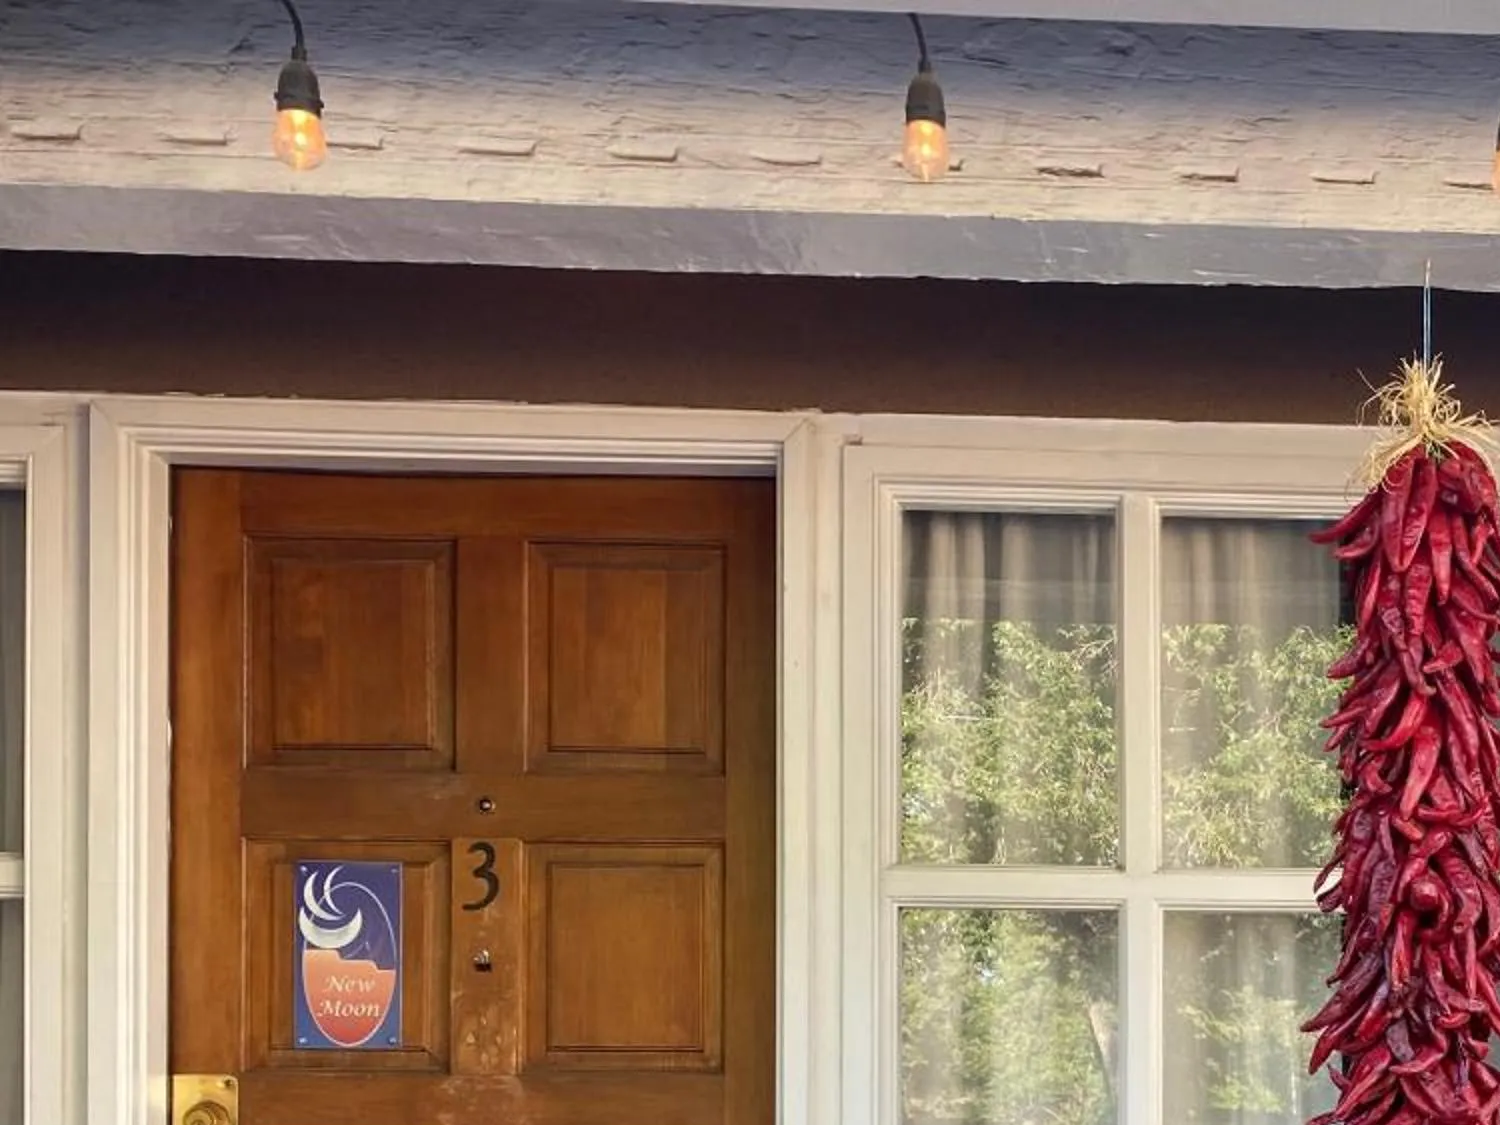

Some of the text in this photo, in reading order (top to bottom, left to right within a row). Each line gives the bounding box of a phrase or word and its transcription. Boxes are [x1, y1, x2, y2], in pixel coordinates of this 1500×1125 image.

[462, 842, 500, 911] 3
[323, 975, 376, 993] New
[318, 1000, 380, 1018] Moon
